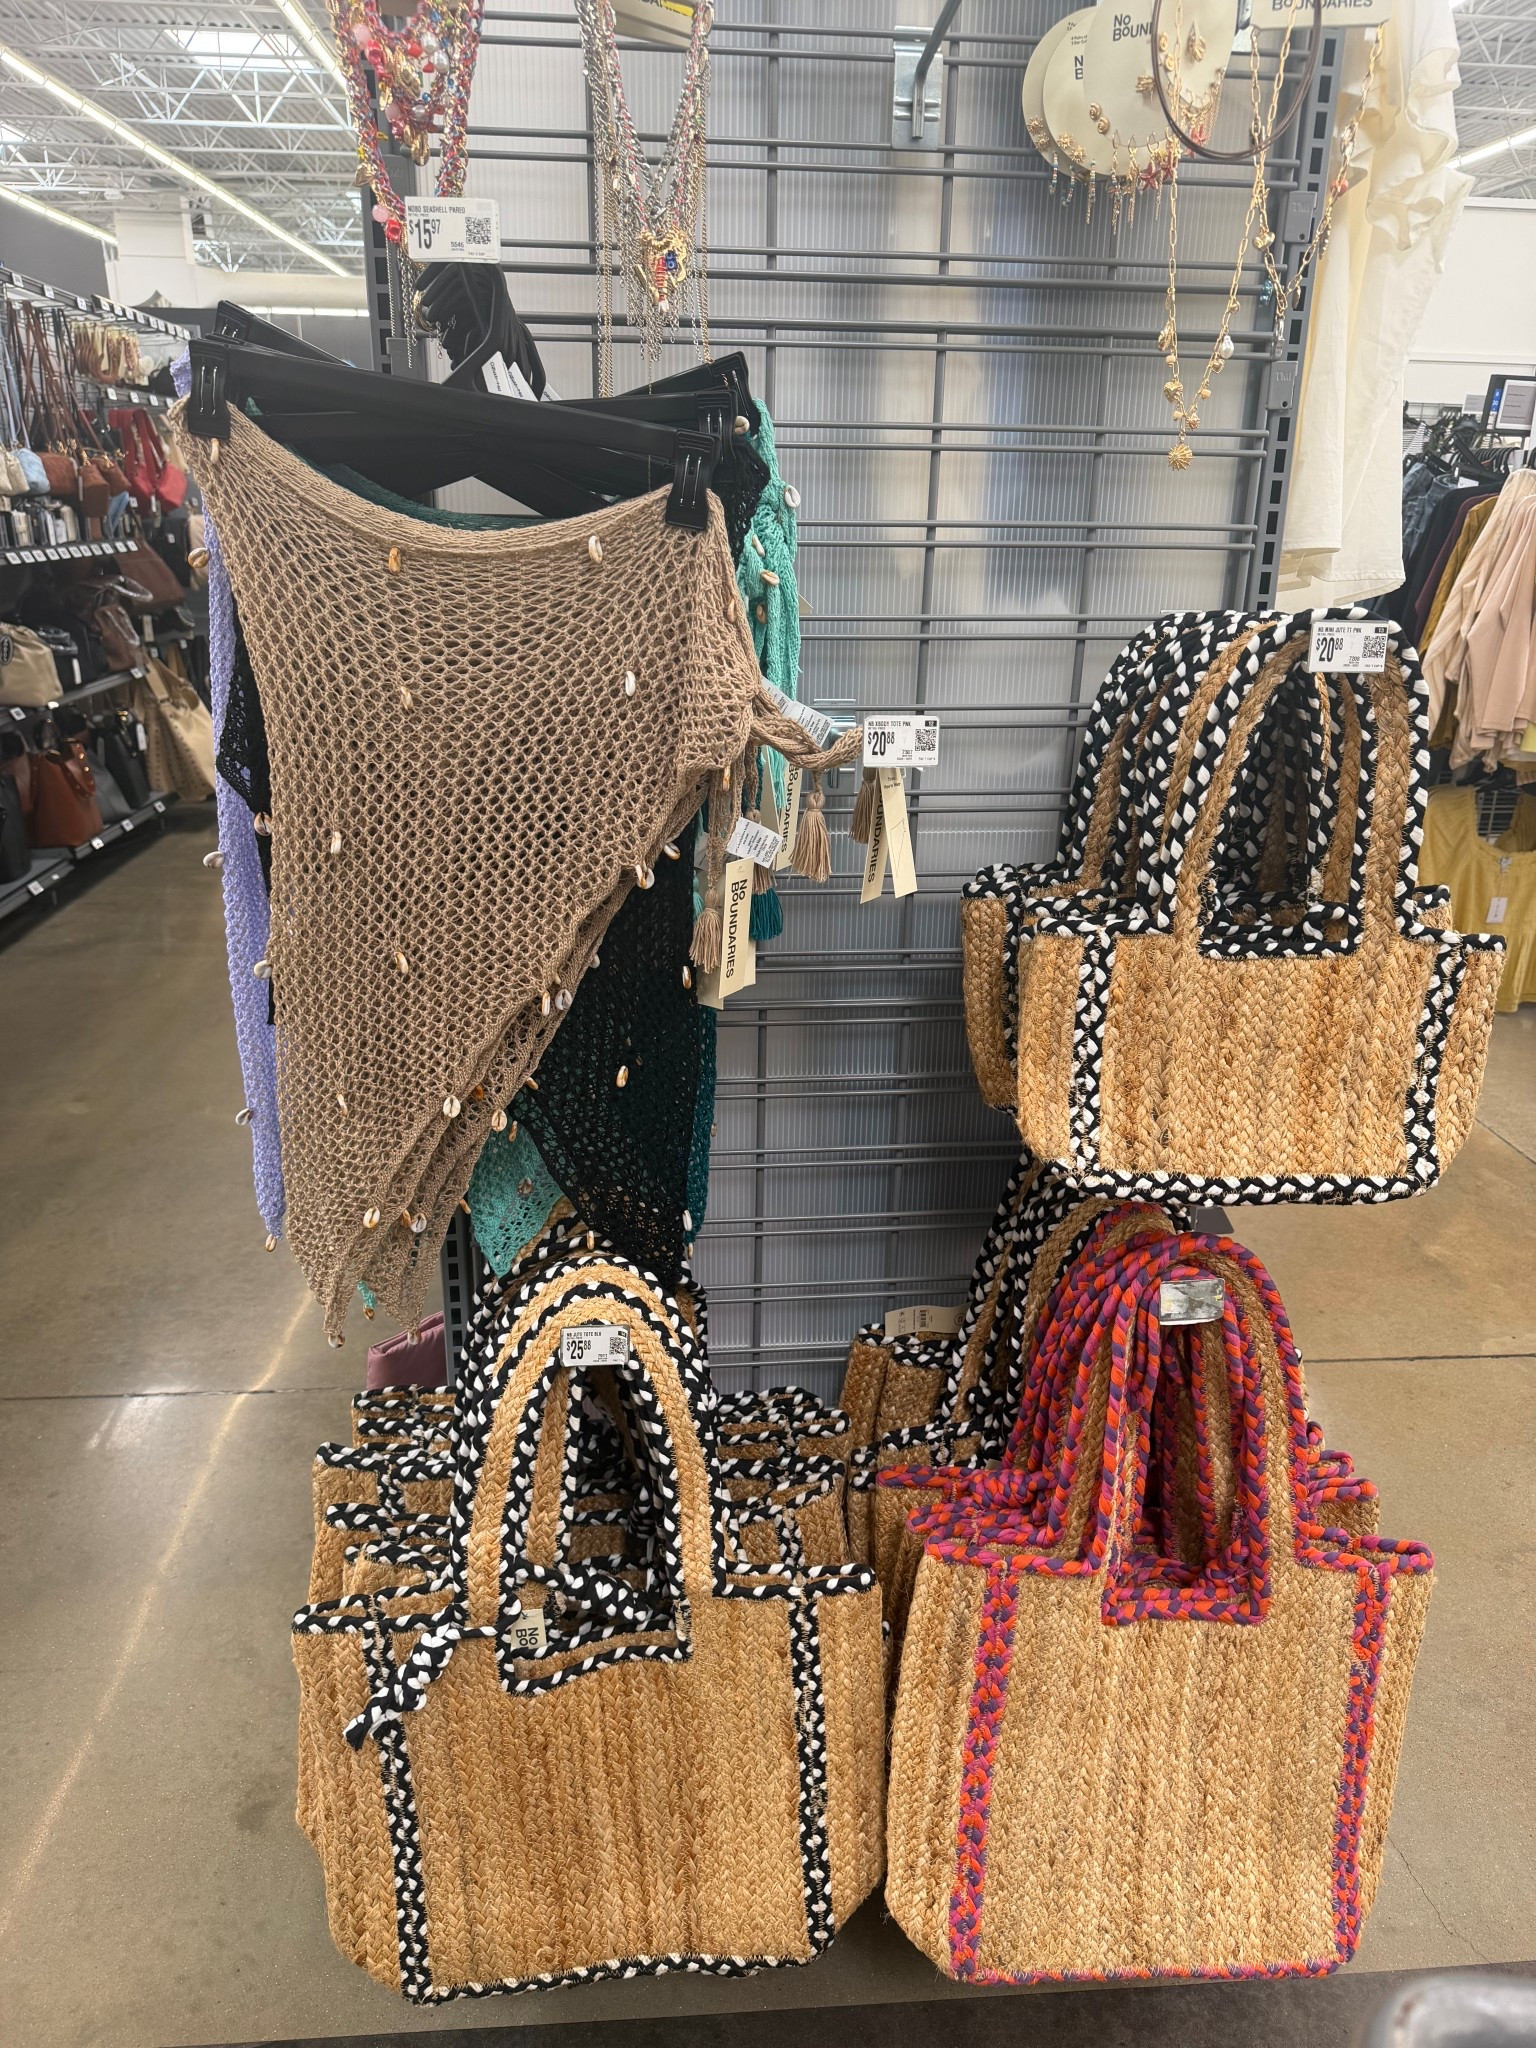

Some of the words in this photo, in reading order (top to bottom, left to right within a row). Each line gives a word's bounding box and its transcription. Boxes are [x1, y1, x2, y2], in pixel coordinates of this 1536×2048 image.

[1114, 13, 1131, 28] NO
[739, 878, 748, 901] NO
[726, 881, 740, 979] BOUNDARIES
[516, 1629, 528, 1646] BO
[528, 1627, 539, 1645] NO
